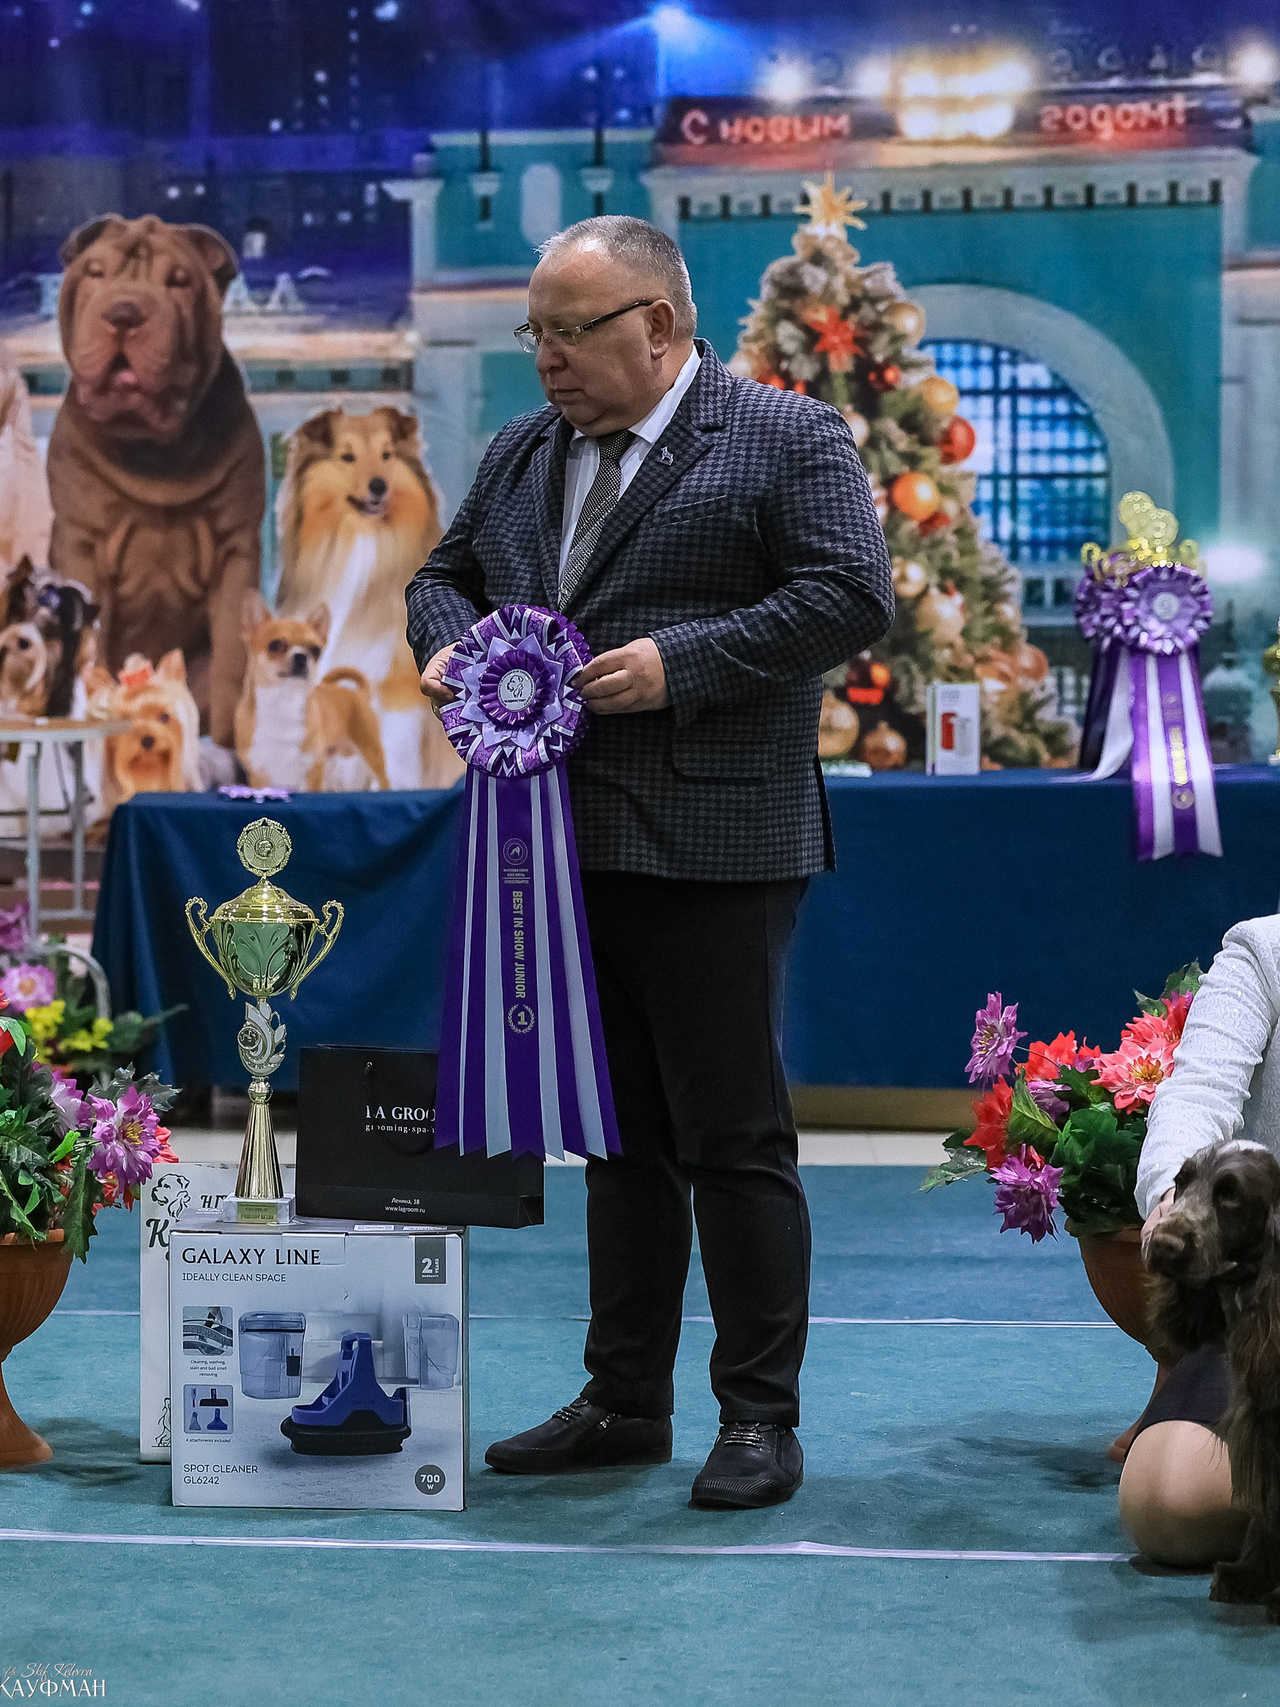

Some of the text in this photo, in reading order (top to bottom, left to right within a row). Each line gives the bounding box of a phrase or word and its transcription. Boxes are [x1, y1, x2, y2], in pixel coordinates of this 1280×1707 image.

[512, 890, 524, 914] BEST
[513, 917, 524, 928] IN
[513, 929, 525, 960] SHOW
[514, 961, 526, 999] JUNIOR
[517, 1011, 528, 1025] 1
[182, 1248, 321, 1265] GALAXY LINE
[422, 1258, 433, 1274] 2
[183, 1272, 286, 1282] IDEALLY CLEAN SPACE
[183, 1464, 259, 1474] SPOT CLEANER
[183, 1476, 220, 1485] GL6242
[420, 1474, 440, 1483] 700
